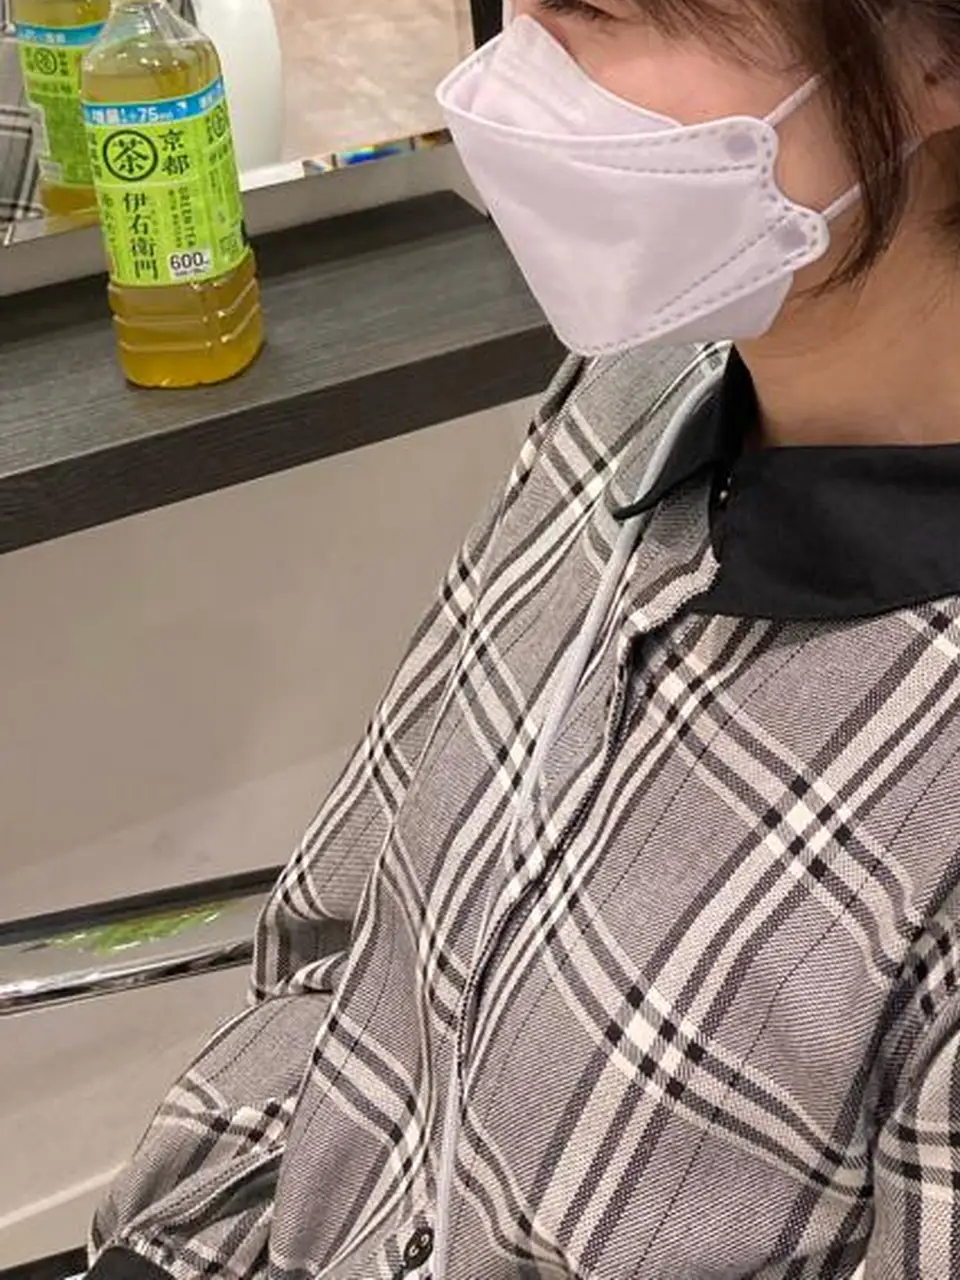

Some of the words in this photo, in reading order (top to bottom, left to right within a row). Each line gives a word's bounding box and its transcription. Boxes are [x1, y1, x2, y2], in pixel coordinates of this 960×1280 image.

[110, 136, 151, 175] 茶
[158, 128, 191, 176] 京都
[122, 191, 159, 280] 伊右衛門
